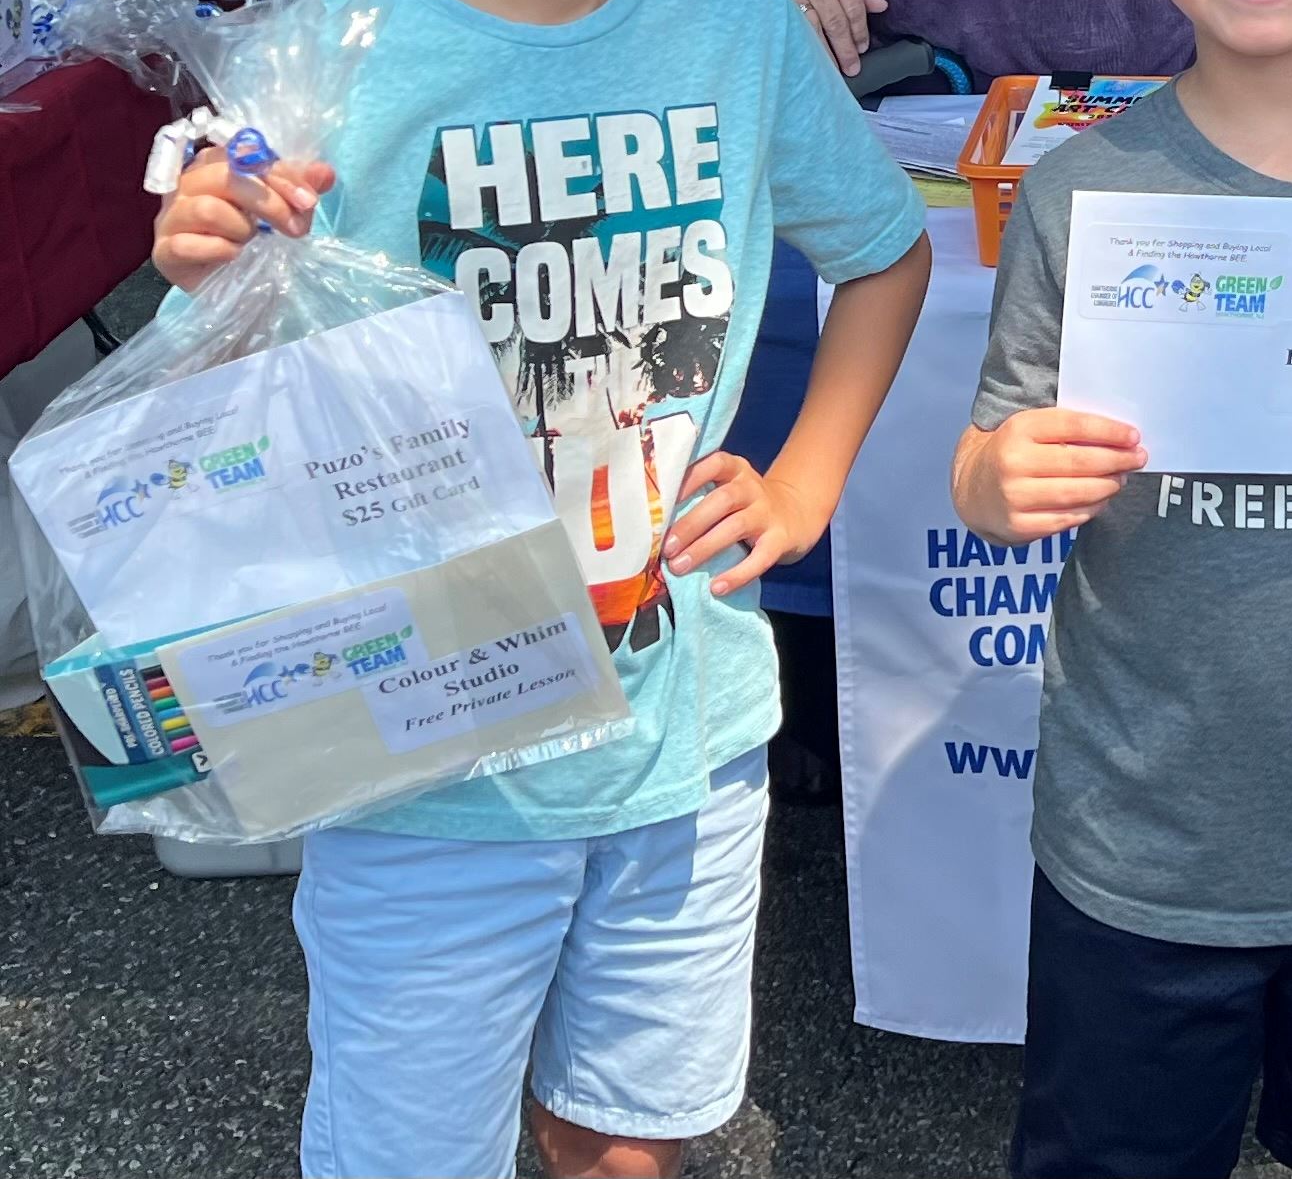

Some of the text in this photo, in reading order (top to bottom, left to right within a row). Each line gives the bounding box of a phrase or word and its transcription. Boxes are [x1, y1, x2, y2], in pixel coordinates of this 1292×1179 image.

[438, 103, 723, 230] HERE
[1167, 240, 1204, 251] Shopping
[1222, 242, 1248, 253] Buying
[456, 220, 734, 343] COMES
[1117, 286, 1155, 309] HCC
[1215, 275, 1268, 295] GREEN
[1214, 292, 1266, 314] TEAM
[304, 419, 471, 479] Puzo's Family
[205, 457, 265, 489] TEAM
[334, 448, 467, 500] Restaurant
[99, 495, 145, 527] HCC
[342, 476, 480, 527] $25 Gift Card
[342, 632, 400, 662] GREEN
[347, 645, 406, 676] TEAM
[379, 621, 568, 695] Colour & Whim
[443, 662, 521, 697] Studio
[119, 668, 165, 756] COLORED PENCILS
[405, 668, 577, 732] Free Private Lesson
[944, 742, 1037, 780] ww
